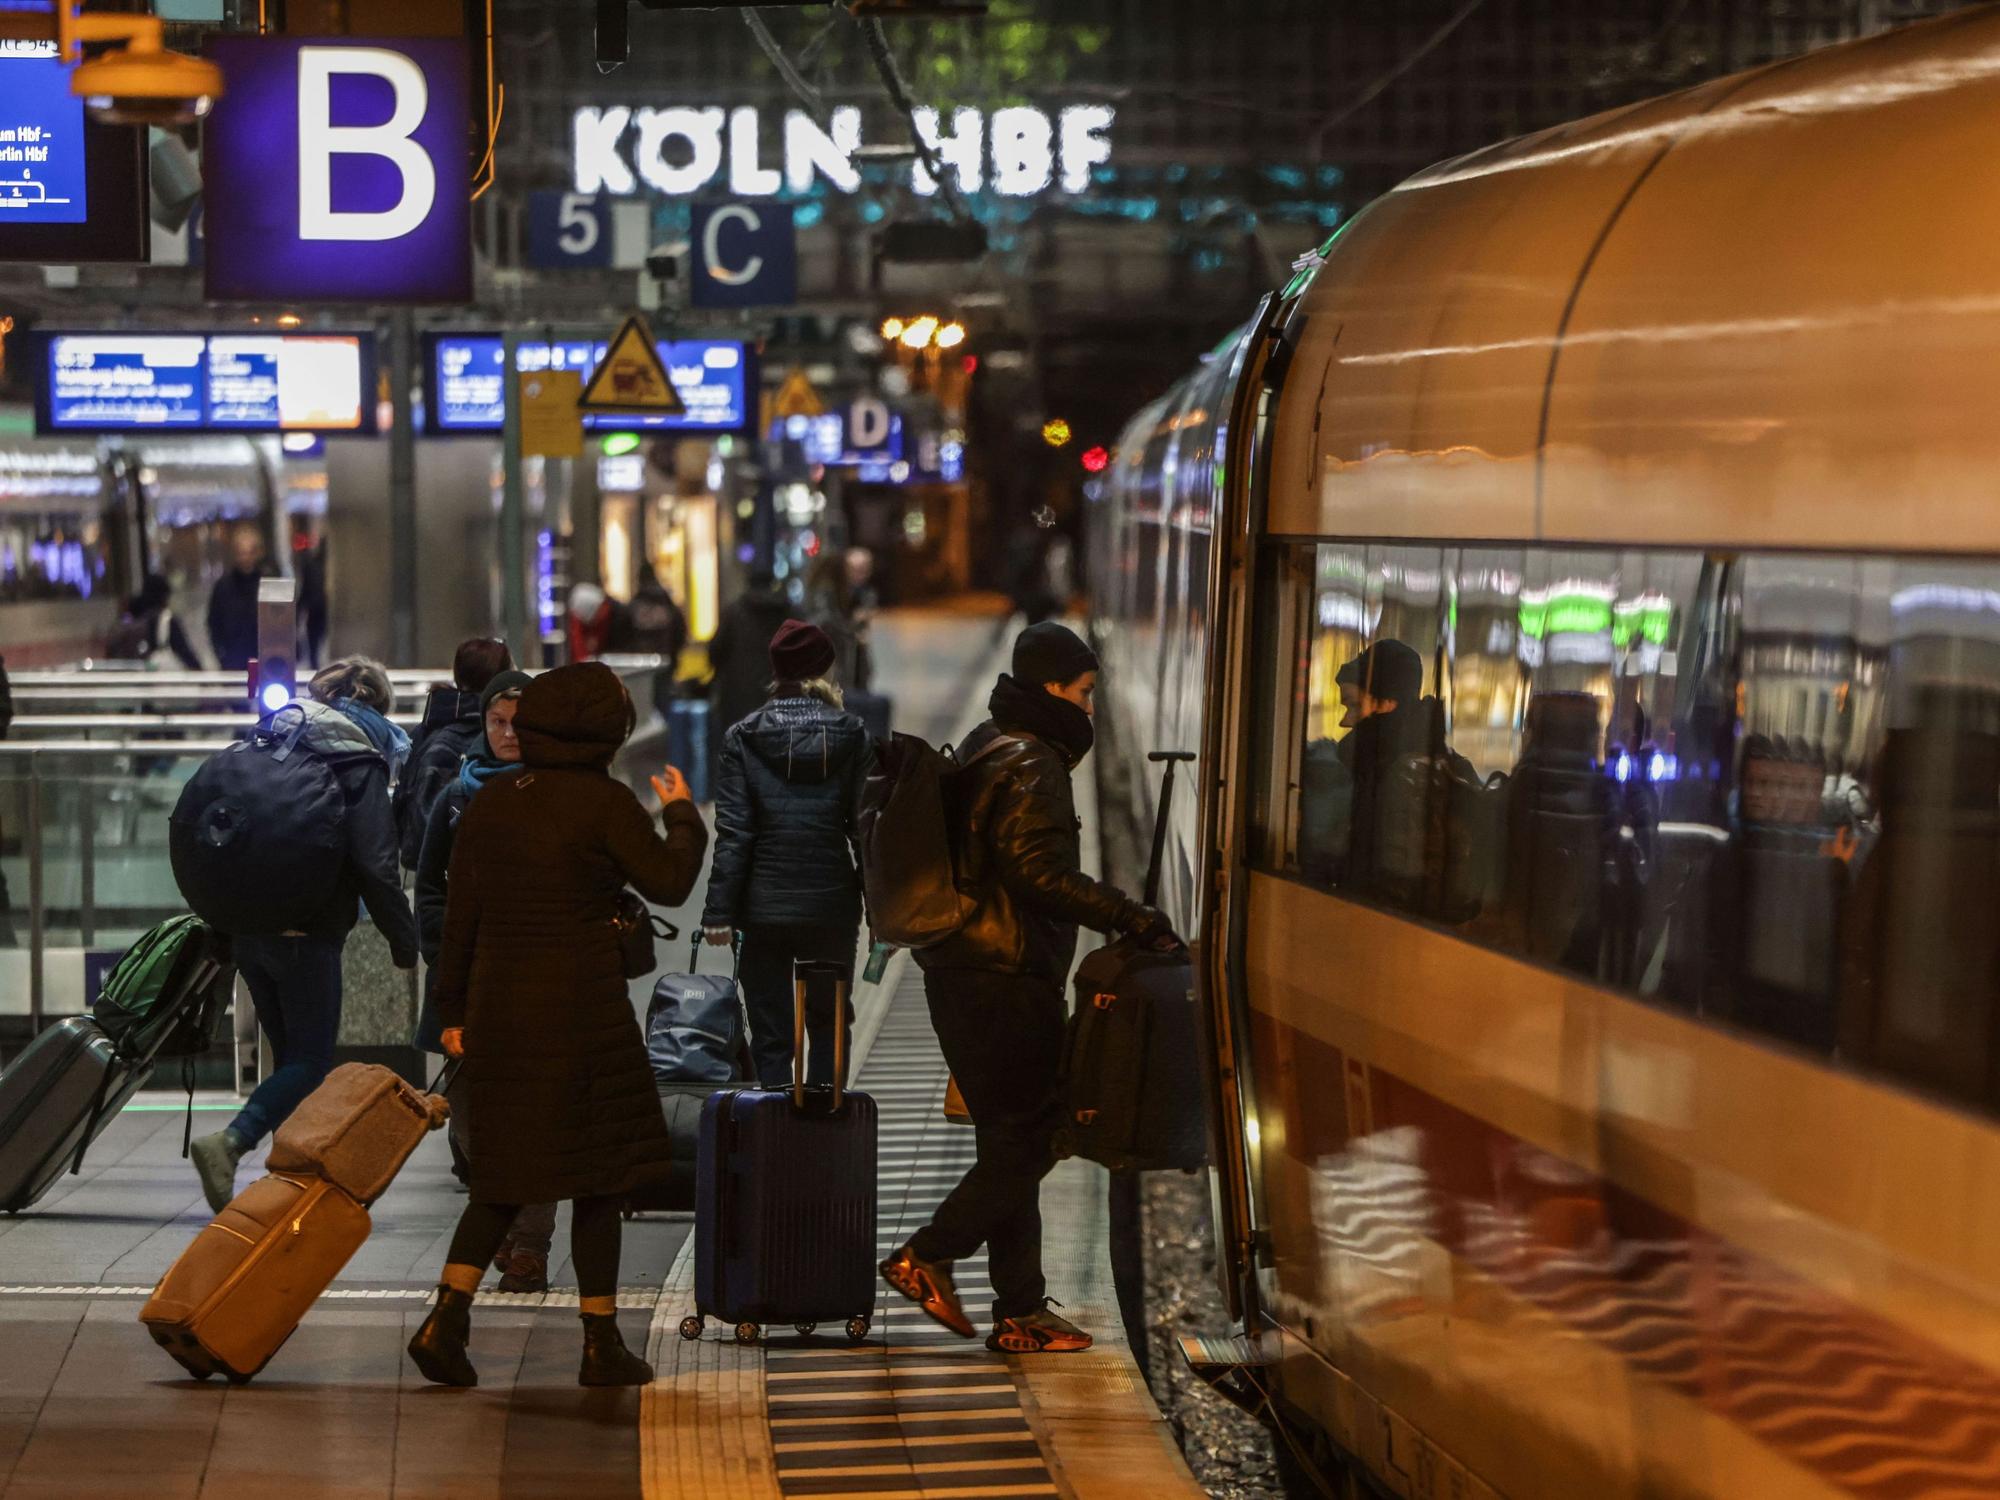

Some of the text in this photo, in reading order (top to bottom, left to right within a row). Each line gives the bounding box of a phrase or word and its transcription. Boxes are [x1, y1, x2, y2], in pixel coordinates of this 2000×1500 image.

[17, 126, 41, 142] Hbf
[25, 145, 48, 162] Hbf
[297, 46, 436, 241] B
[573, 104, 1116, 197] KÖLN HBF
[557, 195, 599, 255] 5
[702, 204, 763, 285] C
[849, 397, 889, 447] D
